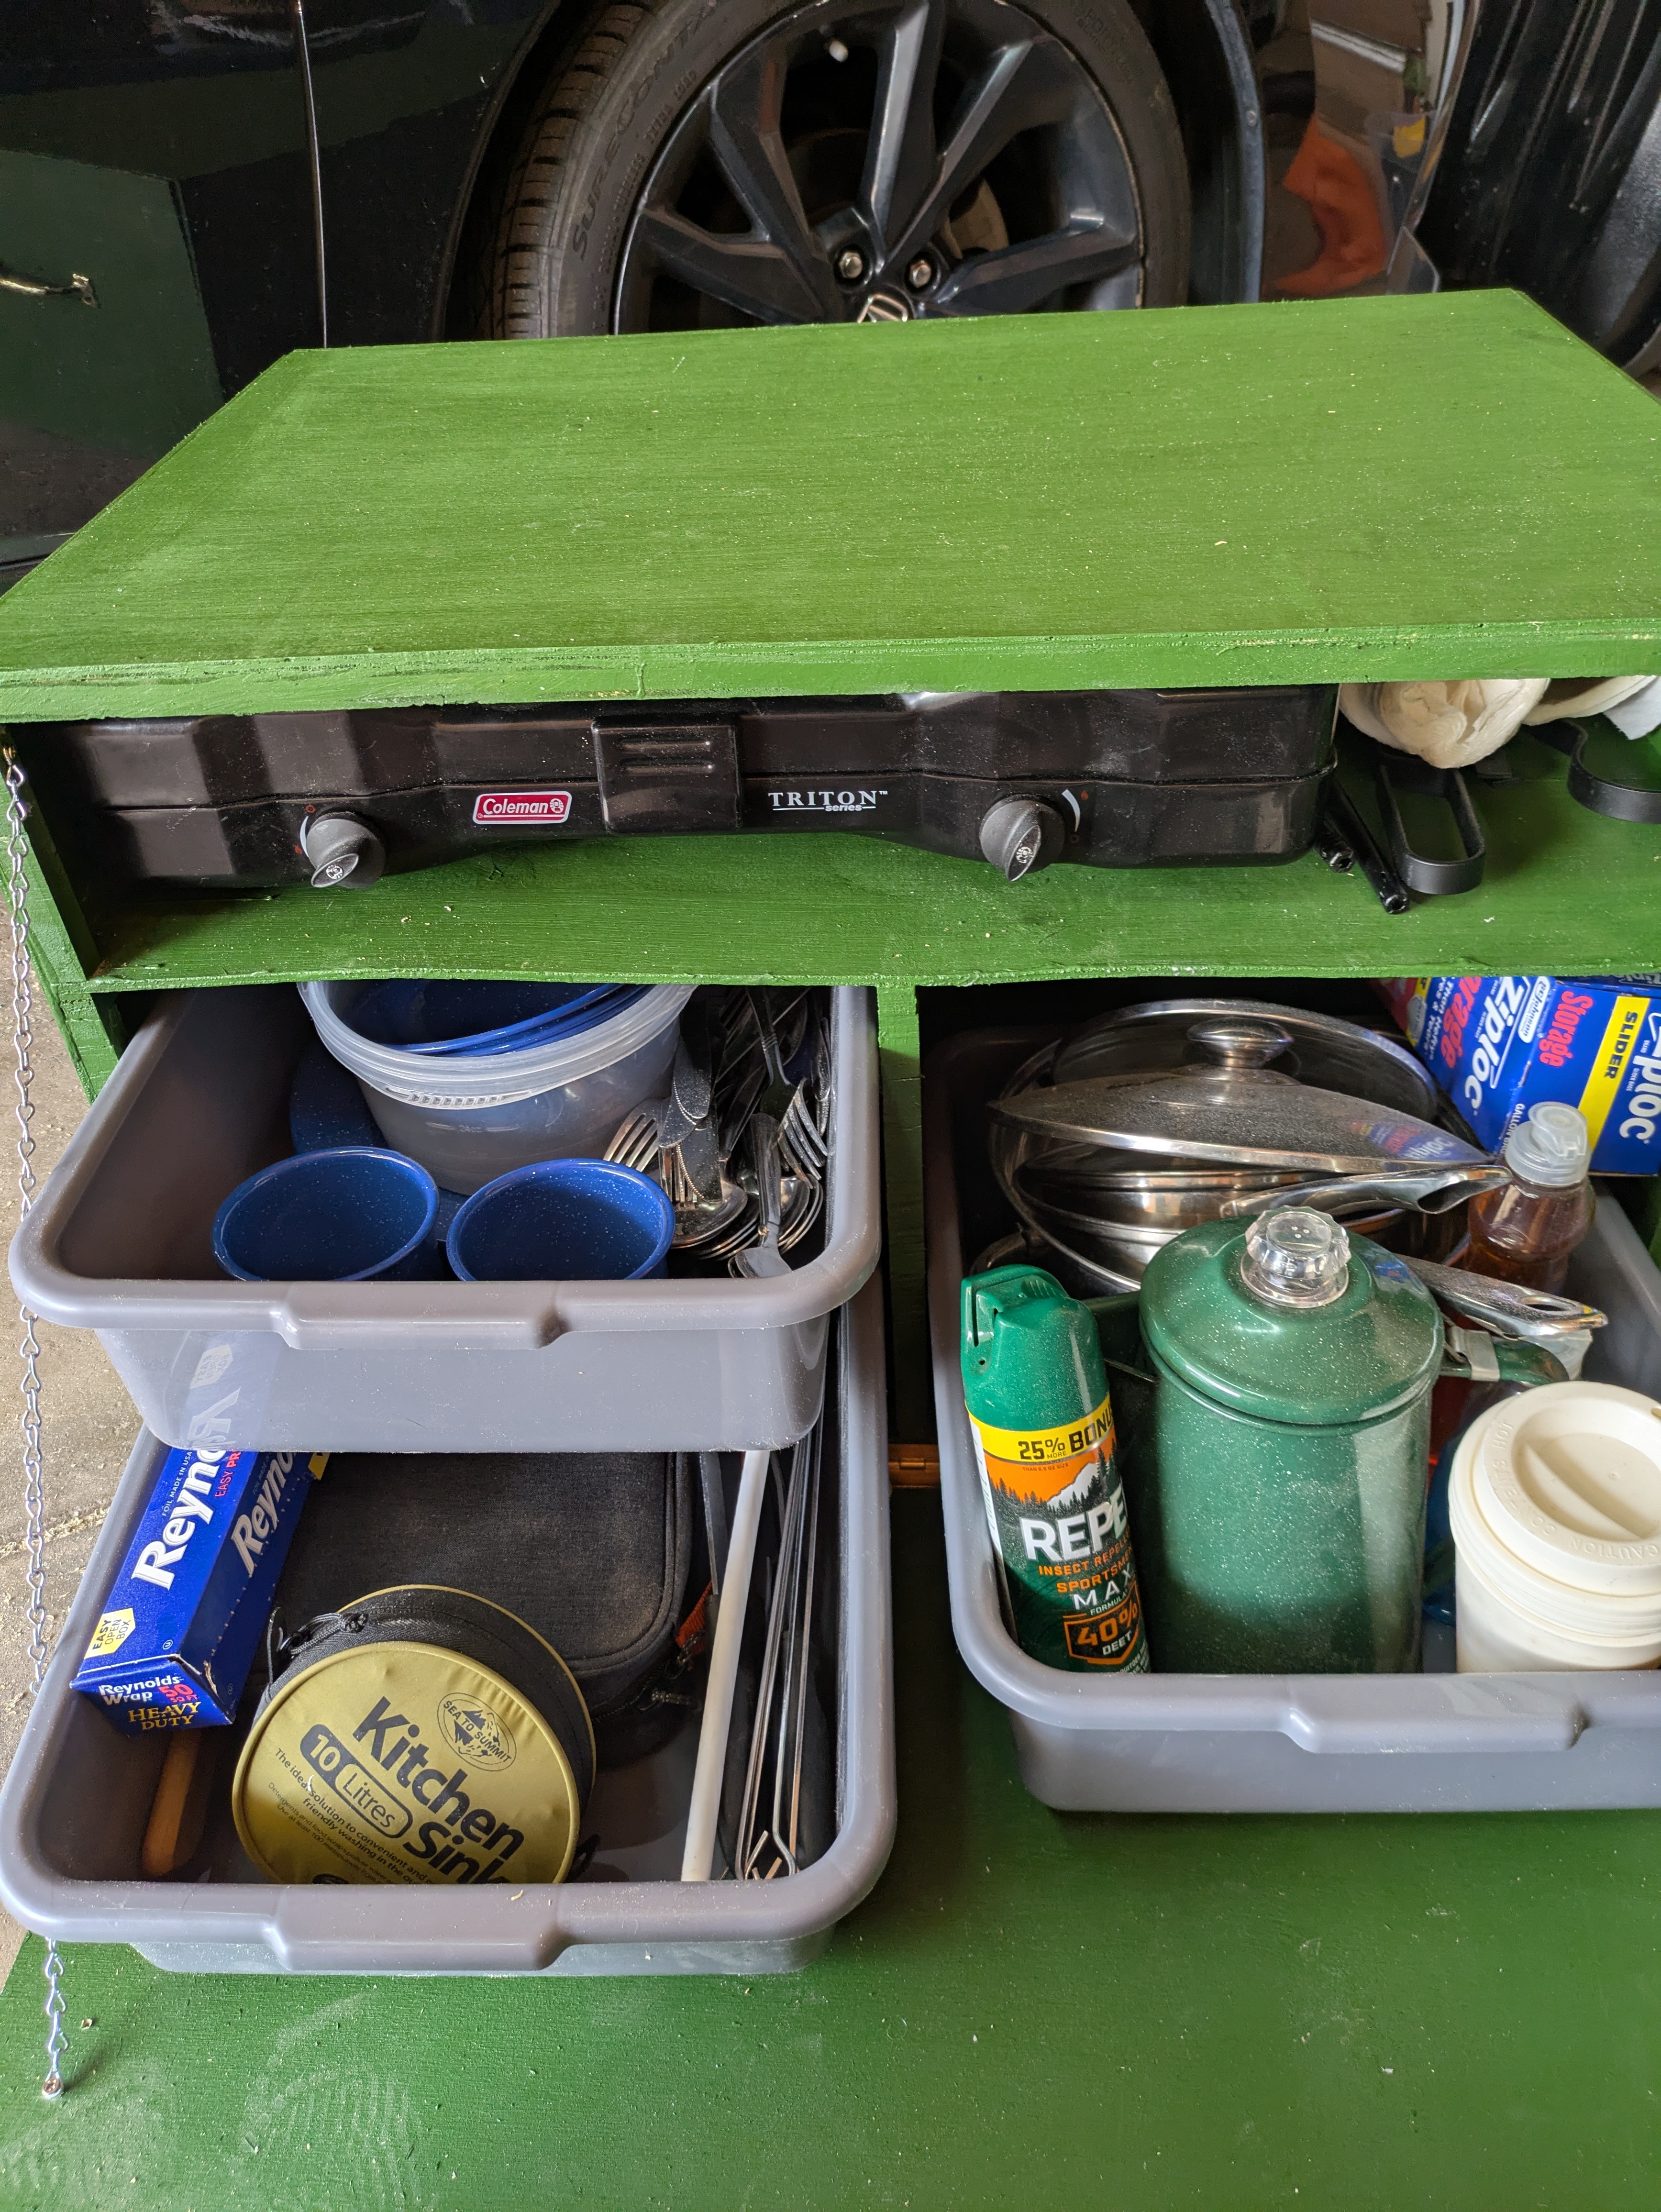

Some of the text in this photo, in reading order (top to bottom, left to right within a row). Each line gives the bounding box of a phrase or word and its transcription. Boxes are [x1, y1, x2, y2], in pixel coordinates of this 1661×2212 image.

[482, 796, 548, 815] Coleman
[824, 803, 862, 812] series
[1464, 977, 1527, 1109] Ziploc
[1539, 991, 1594, 1068] Storage
[1604, 1011, 1639, 1080] SLIDER
[1018, 1405, 1113, 1461] 25% BONU
[1492, 1421, 1514, 1450] HOT
[1047, 1450, 1067, 1460] MORE
[162, 1499, 174, 1516] FOIL
[169, 1476, 183, 1497] MADE
[182, 1450, 193, 1465] USA
[214, 1470, 234, 1498] EASY
[1571, 1536, 1661, 1559] CAUTION
[1038, 1560, 1090, 1577] INSECT
[1074, 1563, 1135, 1610] MAX
[1090, 1587, 1129, 1615] FORMULA
[92, 1619, 111, 1650] EASY
[104, 1618, 122, 1645] OPEN
[116, 1620, 132, 1640] BOX
[1077, 1602, 1139, 1648] 40%
[1102, 1631, 1133, 1656] DEET
[99, 1675, 180, 1696] Reynolds
[103, 1690, 153, 1705] Wrap
[159, 1683, 194, 1700] 50
[129, 1701, 201, 1723] HEAVY
[142, 1715, 194, 1731] DUTY
[443, 1699, 512, 1764] SEA TO SUMMIT
[310, 1733, 396, 1829] 10 Litres
[353, 1696, 525, 1860] Kitchen
[275, 1747, 291, 1769] The
[290, 1765, 313, 1791] idea
[309, 1788, 346, 1826] solution
[344, 1820, 357, 1834] to
[356, 1829, 408, 1874] convenient
[407, 1863, 426, 1882] and
[302, 1798, 338, 1834] friendly
[338, 1828, 377, 1859] washing
[387, 1859, 403, 1877] the
